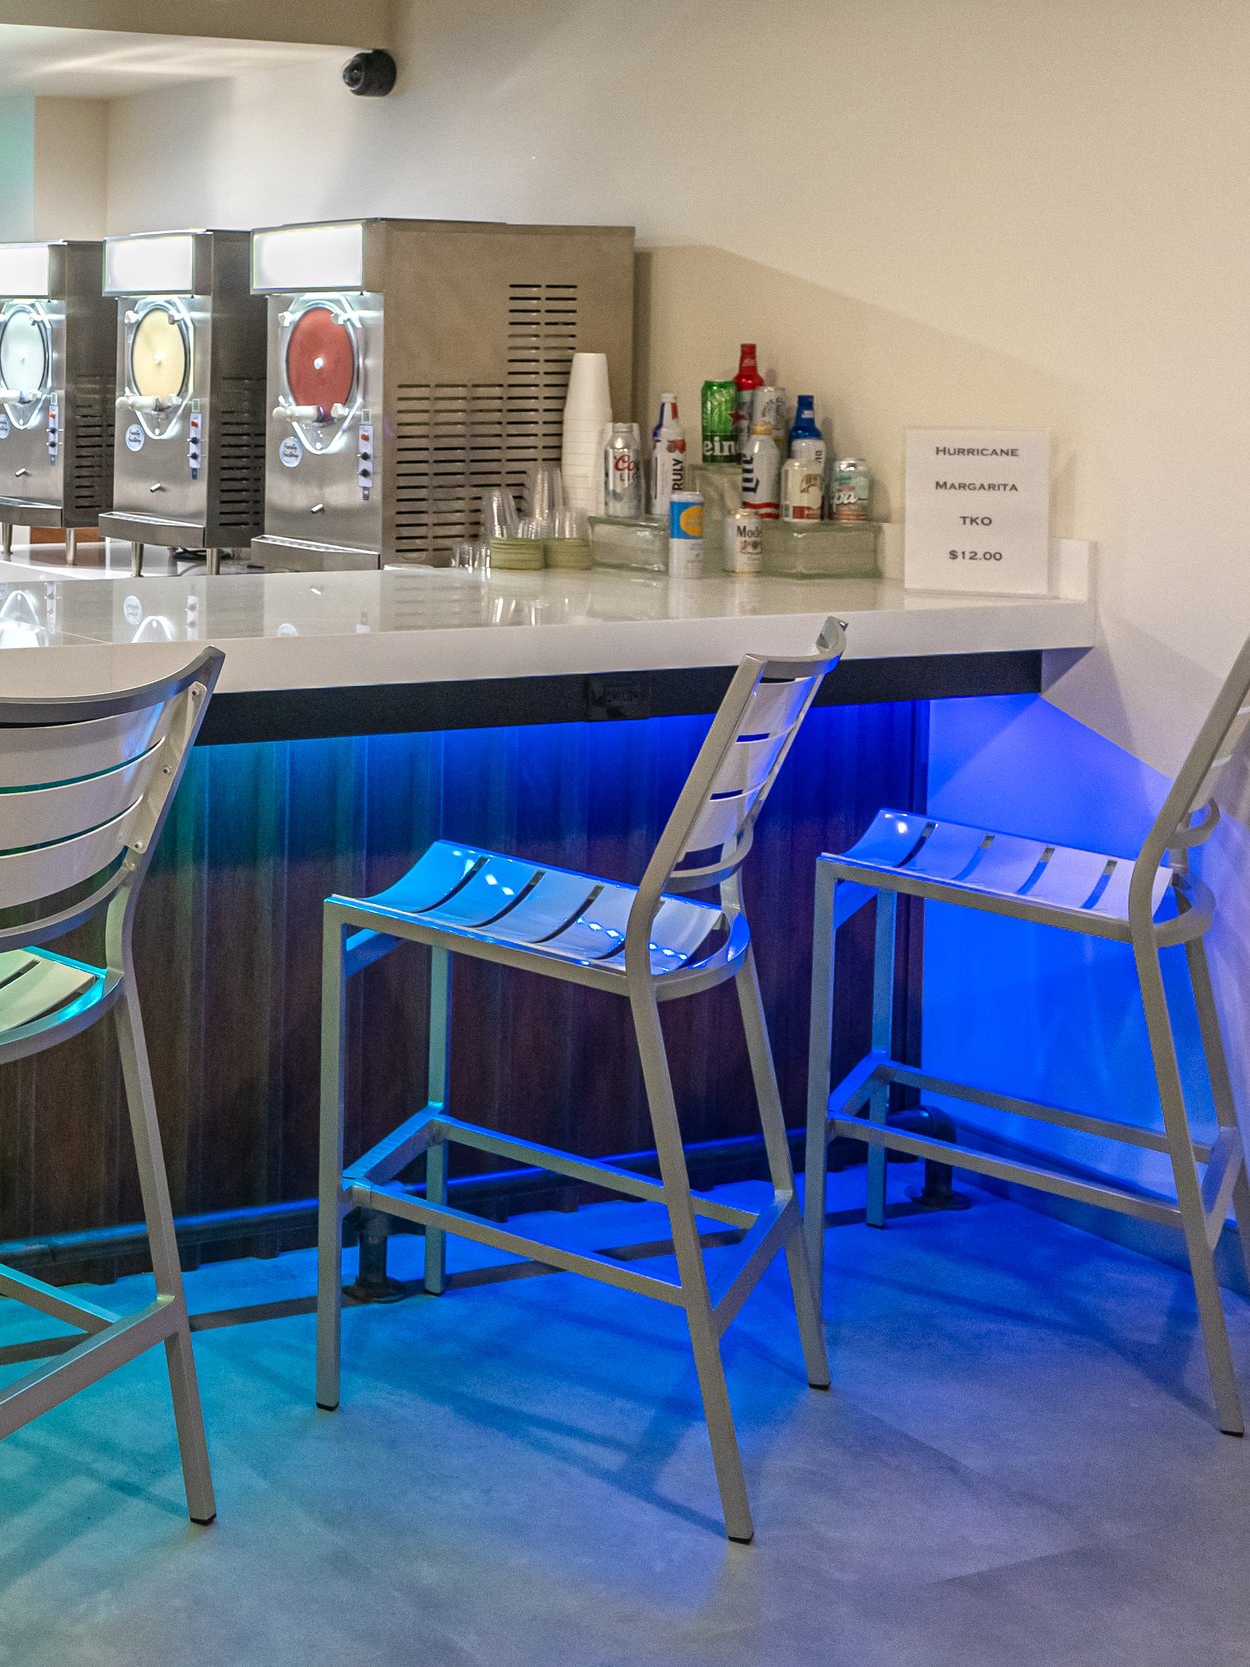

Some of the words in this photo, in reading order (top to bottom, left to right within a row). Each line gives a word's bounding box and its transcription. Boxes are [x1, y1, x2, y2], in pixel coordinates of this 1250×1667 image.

[935, 446, 1020, 457] HURRICANE
[671, 458, 685, 491] RULY
[935, 480, 1019, 492] MARGARITA
[959, 515, 993, 526] TKO
[736, 525, 763, 539] Mode
[948, 549, 1003, 561] $12.00
